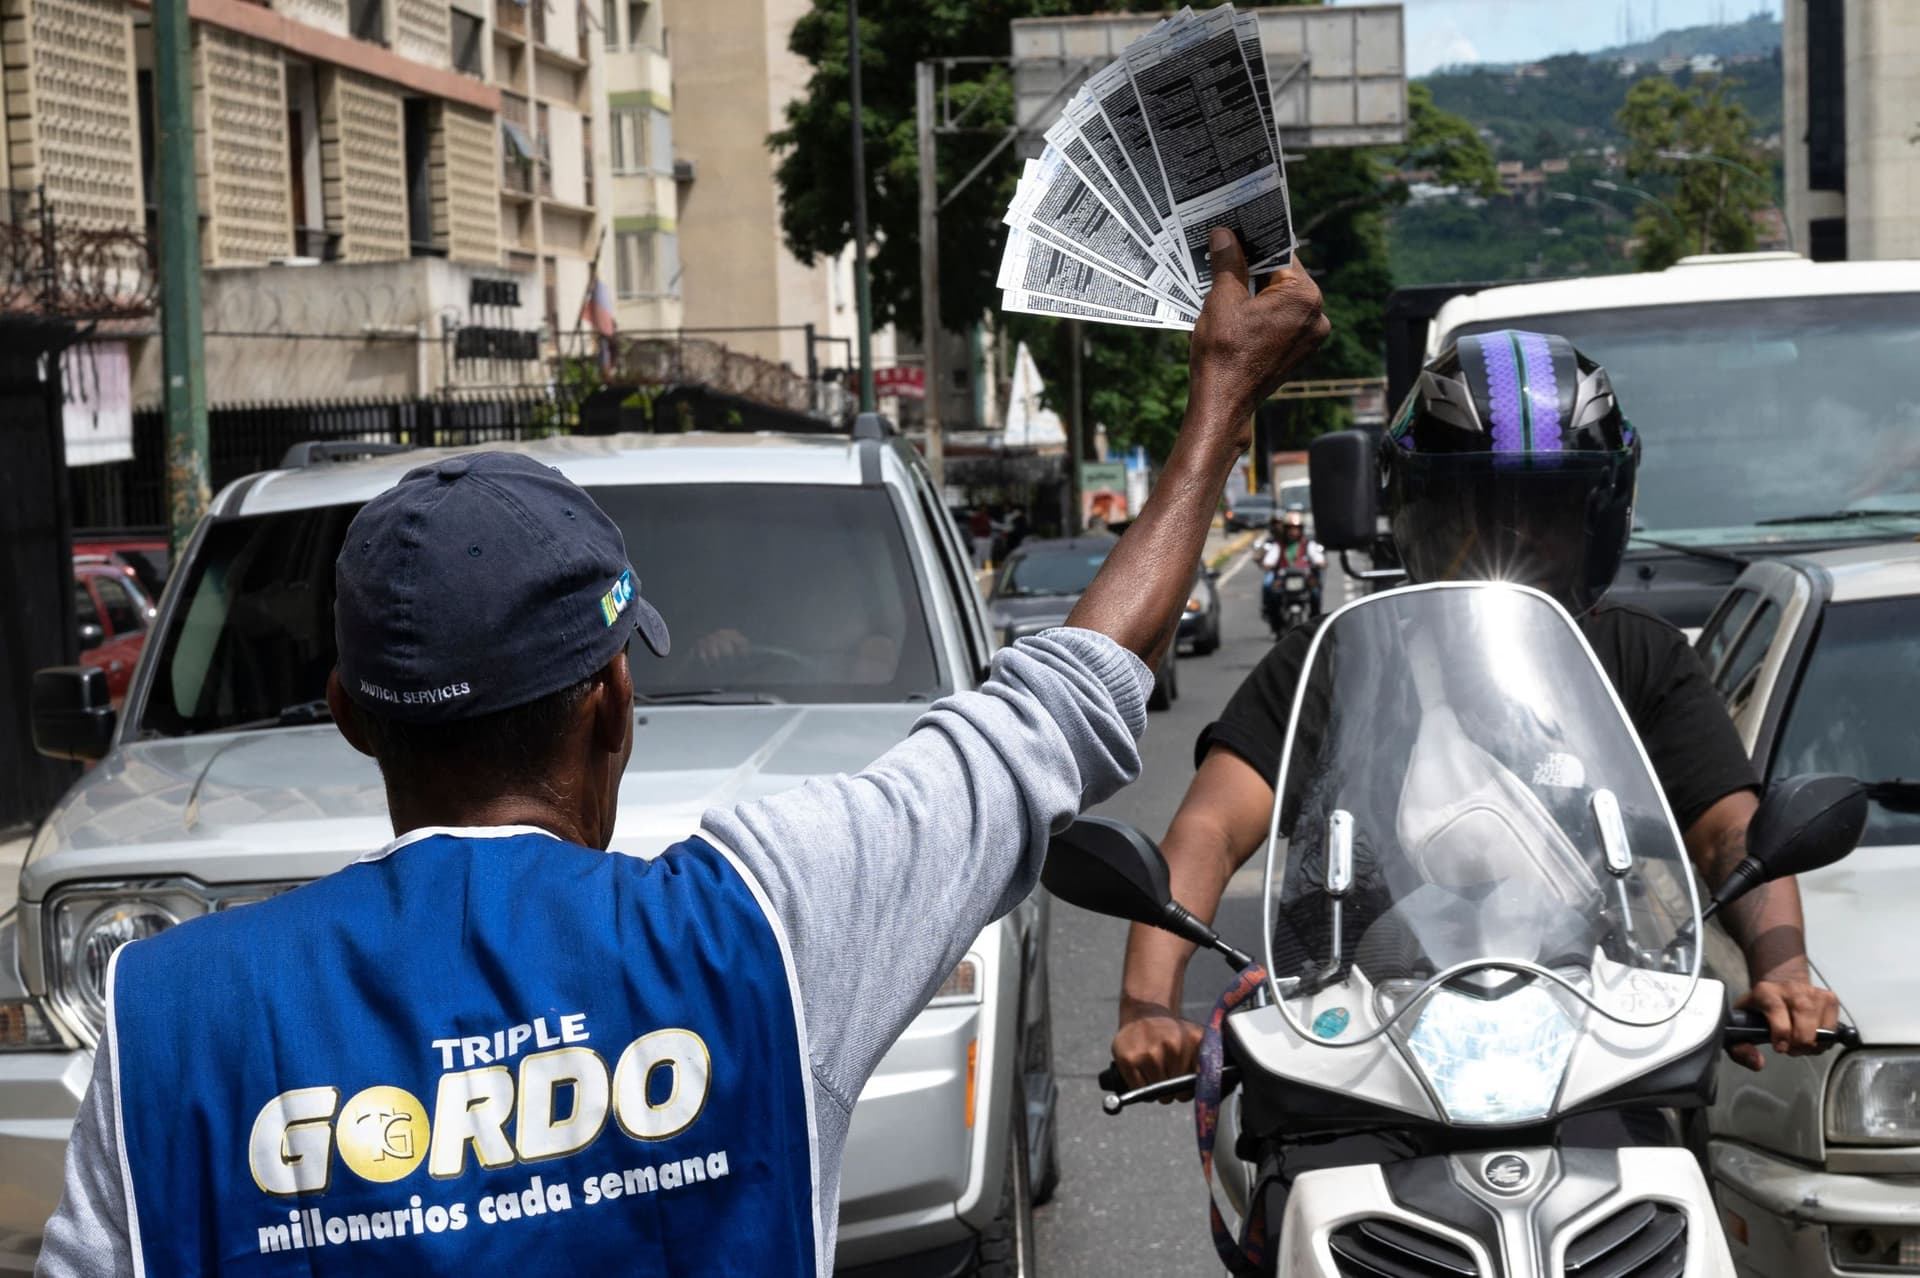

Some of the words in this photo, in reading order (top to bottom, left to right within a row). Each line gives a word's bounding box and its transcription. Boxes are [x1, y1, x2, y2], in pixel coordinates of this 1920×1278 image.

[402, 682, 470, 704] SERVICES
[431, 1012, 591, 1069] TRIPLE
[248, 1028, 713, 1197] GORDO
[257, 1195, 468, 1254] millonarios
[478, 1176, 572, 1224] cada
[584, 1150, 730, 1205] semana
